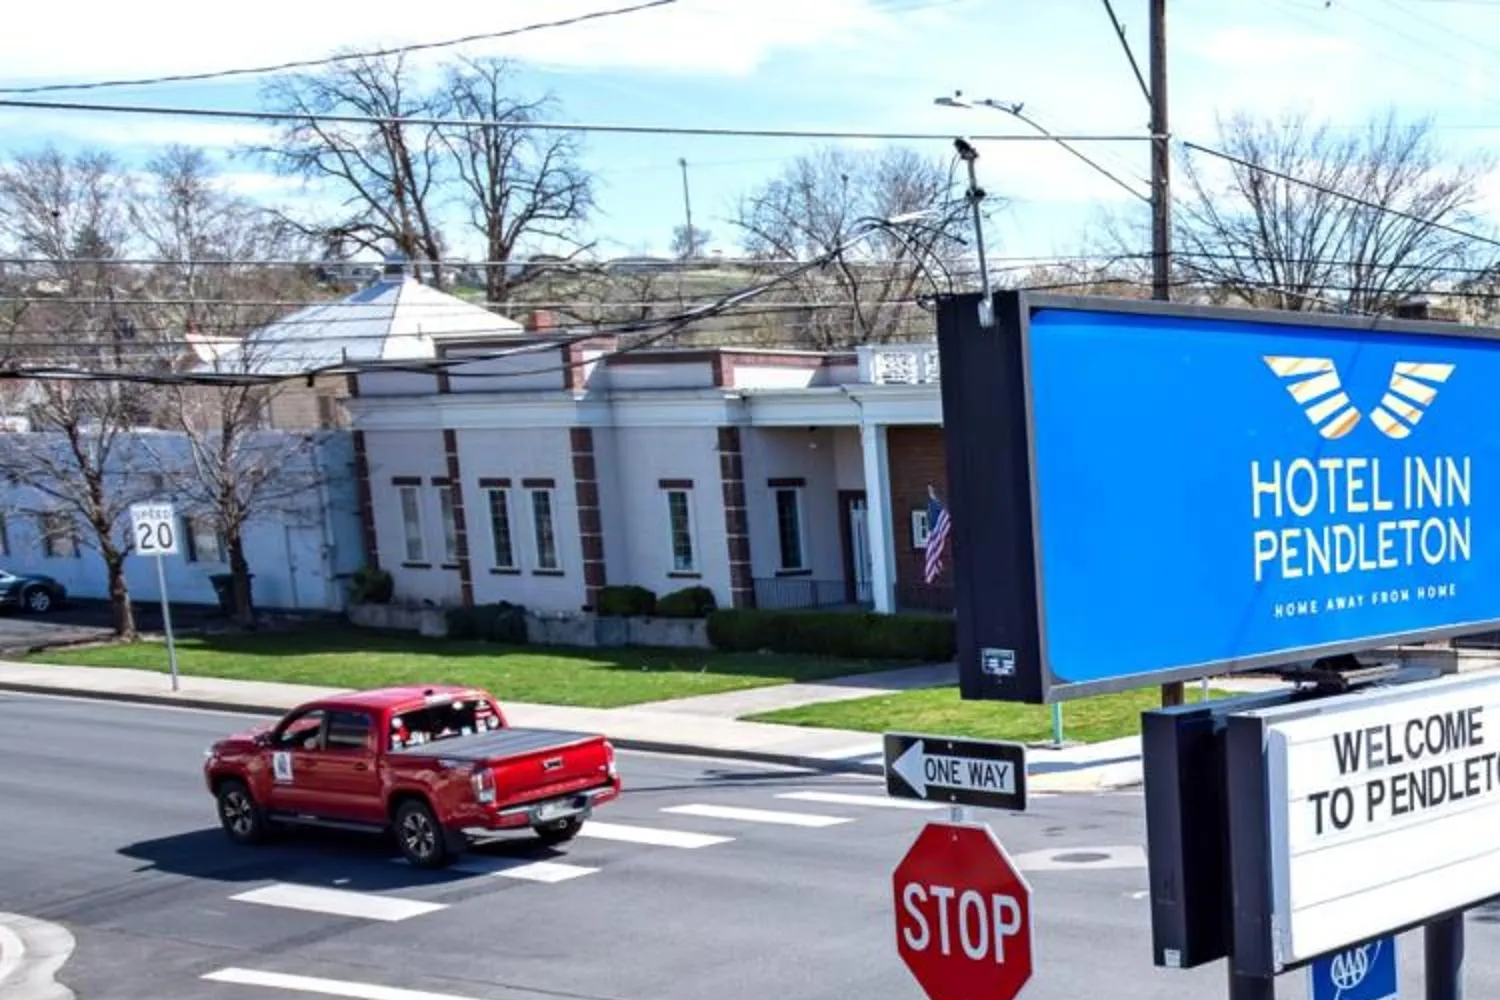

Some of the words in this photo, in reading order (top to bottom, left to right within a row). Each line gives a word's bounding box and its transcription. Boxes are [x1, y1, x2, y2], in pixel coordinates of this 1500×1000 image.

[1251, 457, 1393, 519] HOTEL
[1404, 456, 1471, 510] INN
[137, 522, 173, 549] 20
[1253, 516, 1471, 582] PENDLETON
[1274, 600, 1319, 618] HOME
[1326, 595, 1364, 611] AWAY
[1372, 589, 1409, 605] FROM
[1417, 583, 1456, 599] HOME
[1333, 705, 1484, 775] WELCOME
[924, 757, 962, 785] ONE
[968, 761, 1009, 789] WAY
[1308, 786, 1354, 835] TO
[903, 882, 1021, 963] STOP
[1333, 948, 1367, 983] AAA
